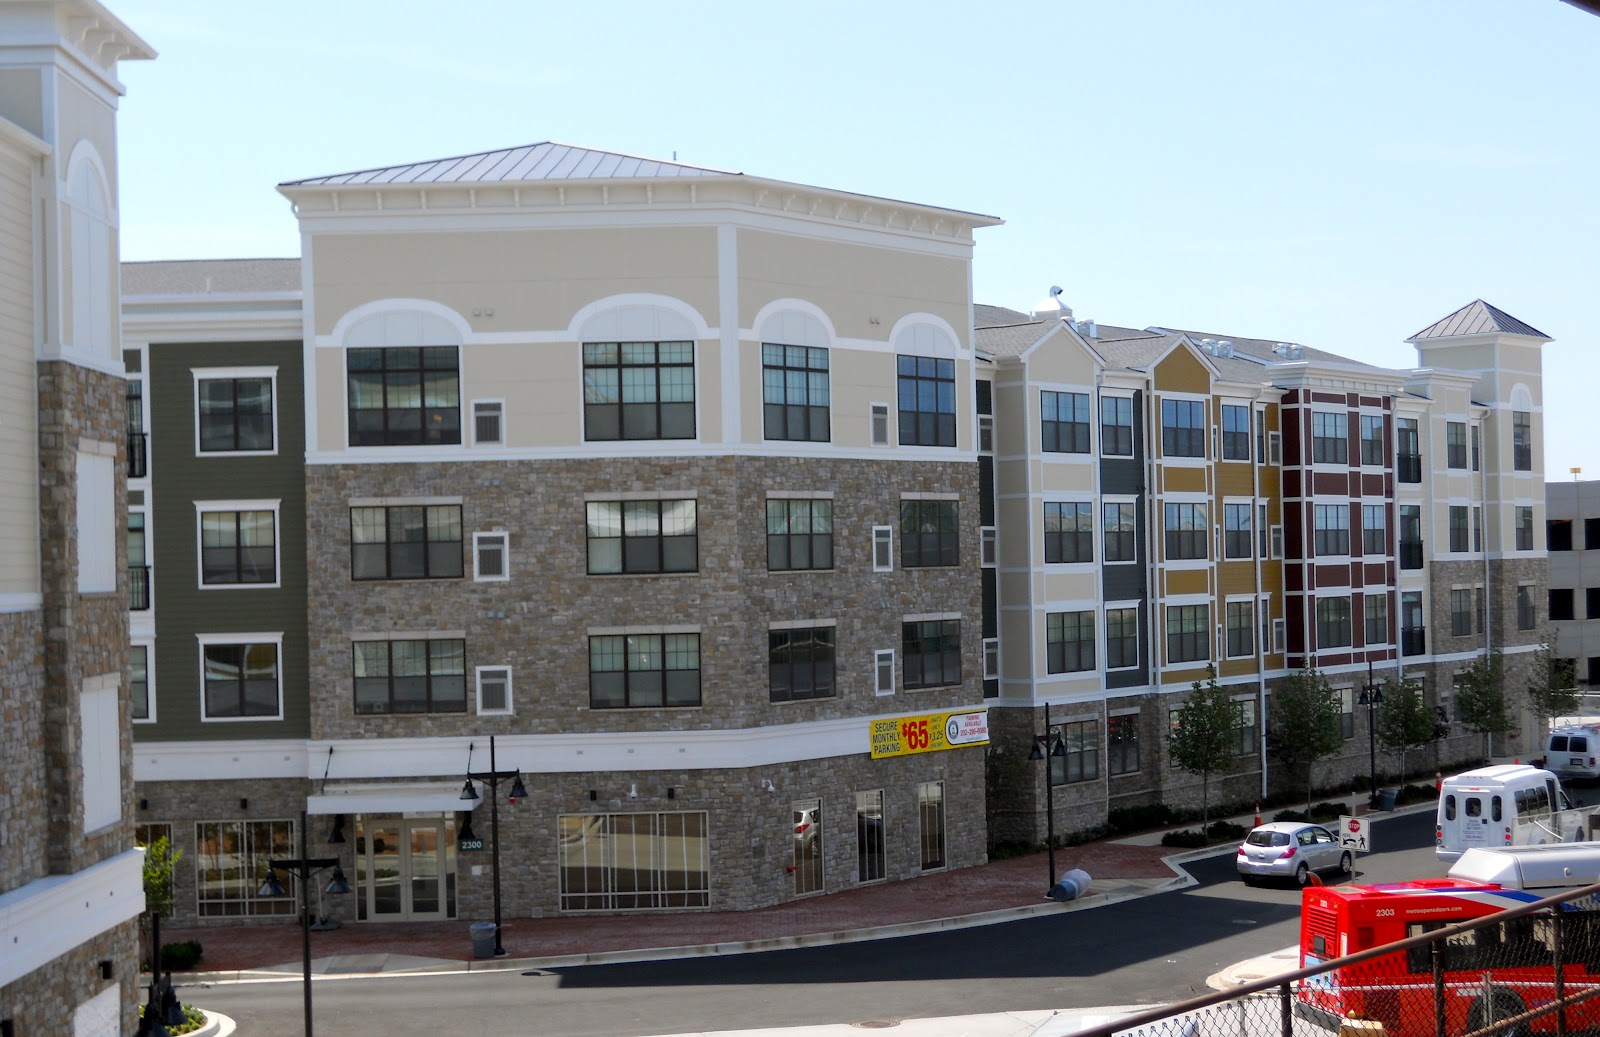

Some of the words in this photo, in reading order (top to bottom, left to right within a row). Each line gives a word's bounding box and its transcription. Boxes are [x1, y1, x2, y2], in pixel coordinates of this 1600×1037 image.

[875, 721, 898, 733] SECURE
[872, 732, 901, 744] MONTHLY
[902, 720, 929, 750] $65
[874, 743, 900, 755] PARKING
[462, 841, 482, 849] 2300
[1376, 908, 1395, 917] 2303
